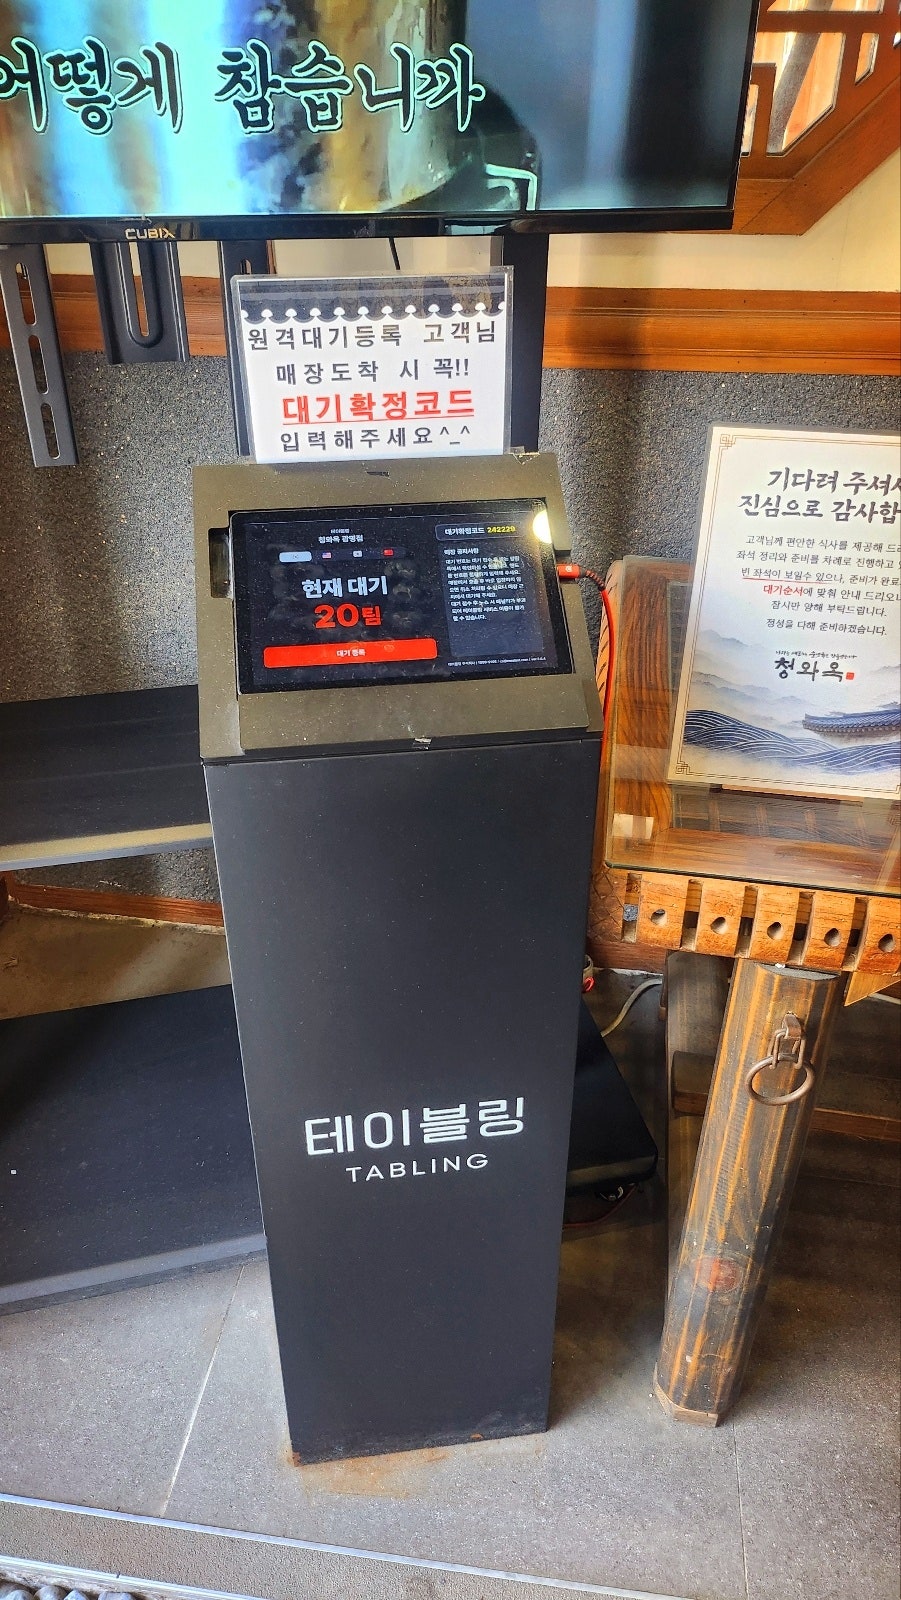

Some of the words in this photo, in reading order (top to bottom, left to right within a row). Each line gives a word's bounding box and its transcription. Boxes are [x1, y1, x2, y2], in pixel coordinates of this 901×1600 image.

[0, 35, 183, 133] 어떻게
[214, 38, 486, 133] 참습니까
[125, 228, 175, 239] CUBIX
[248, 324, 401, 350] 원격대기등록
[423, 320, 496, 343] 고객님
[276, 360, 378, 385] 매장도착
[399, 358, 419, 380] 시
[433, 357, 469, 379] 꼭!!
[283, 389, 474, 423] 대기확정코드
[767, 466, 839, 494] 기다려
[738, 493, 823, 518] 진심으로
[746, 535, 783, 546] 고객님께
[786, 537, 815, 549] 편안한
[818, 539, 848, 551] 식사를
[852, 541, 883, 553] 제공해
[736, 550, 755, 560] 좌석
[758, 551, 788, 563] 정리와
[790, 553, 819, 565] 준비를
[822, 555, 851, 566] 차례로
[855, 557, 894, 569] 진행하고
[302, 577, 343, 599] 현재
[347, 575, 388, 597] 대기
[741, 567, 750, 577] 빈
[753, 568, 781, 579] 좌석이
[784, 570, 812, 582] 보일수
[849, 574, 878, 586] 준비가
[763, 584, 813, 597] 대기순서에
[817, 588, 837, 598] 맞춰
[840, 589, 861, 601] 안내
[314, 602, 382, 629] 20팀
[771, 600, 800, 611] 잠시만
[804, 602, 823, 612] 양해
[827, 604, 887, 617] 부탁드립니다.
[766, 618, 794, 629] 정성을
[797, 620, 815, 631] 다해
[819, 622, 887, 636] 준비하겠습니다.
[336, 649, 350, 658] 대기
[774, 657, 844, 682] 청와옥
[304, 1097, 524, 1156] 테이블링
[346, 1153, 489, 1183] TABLING
